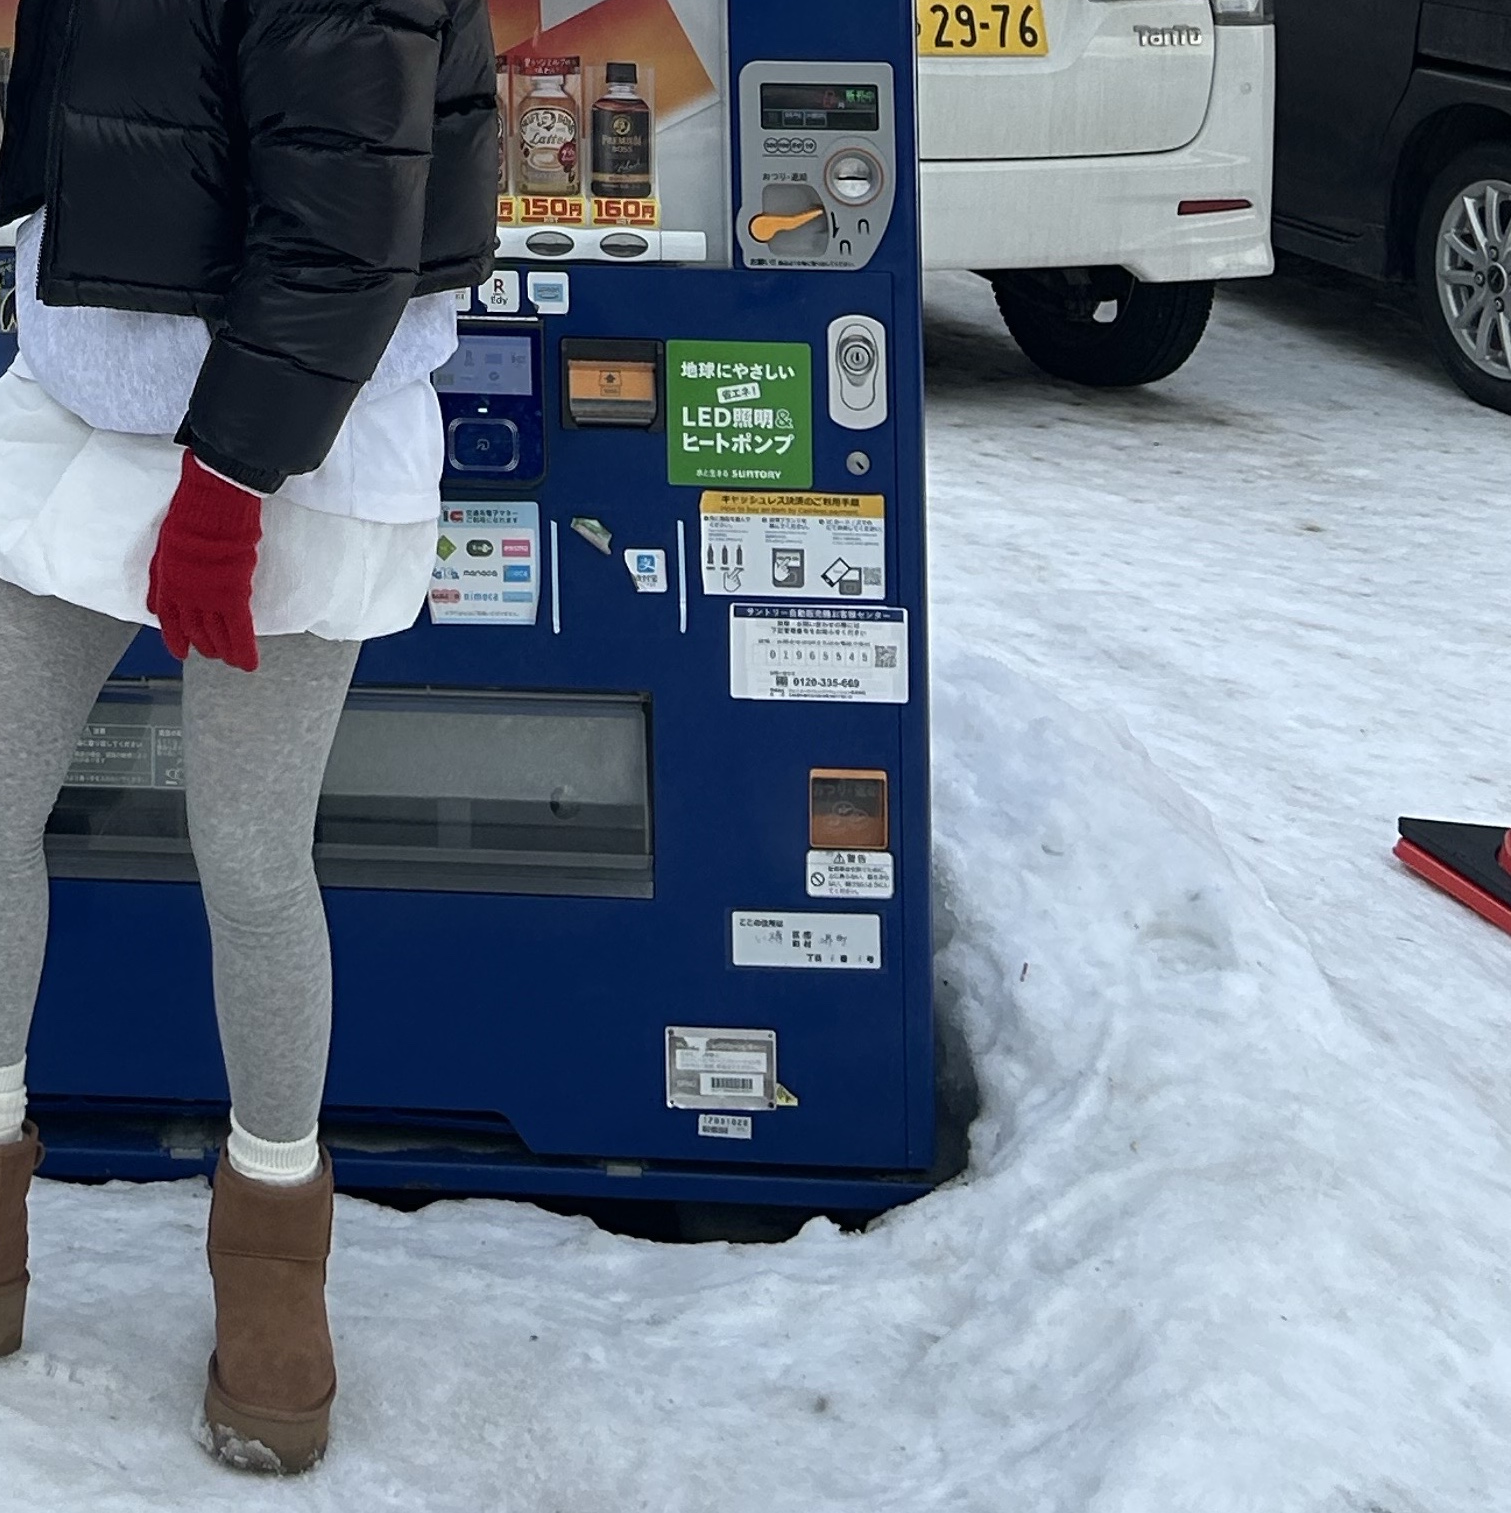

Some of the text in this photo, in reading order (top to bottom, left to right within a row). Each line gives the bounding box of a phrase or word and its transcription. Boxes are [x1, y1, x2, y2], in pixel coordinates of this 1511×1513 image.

[930, 4, 1039, 48] 29-76
[521, 198, 583, 217] 150円
[593, 198, 656, 218] 160円
[680, 361, 796, 380] 地球にやさしい
[682, 406, 794, 429] LED照明&
[682, 432, 795, 455] ヒートポンプ
[732, 469, 782, 480] SUNTORY
